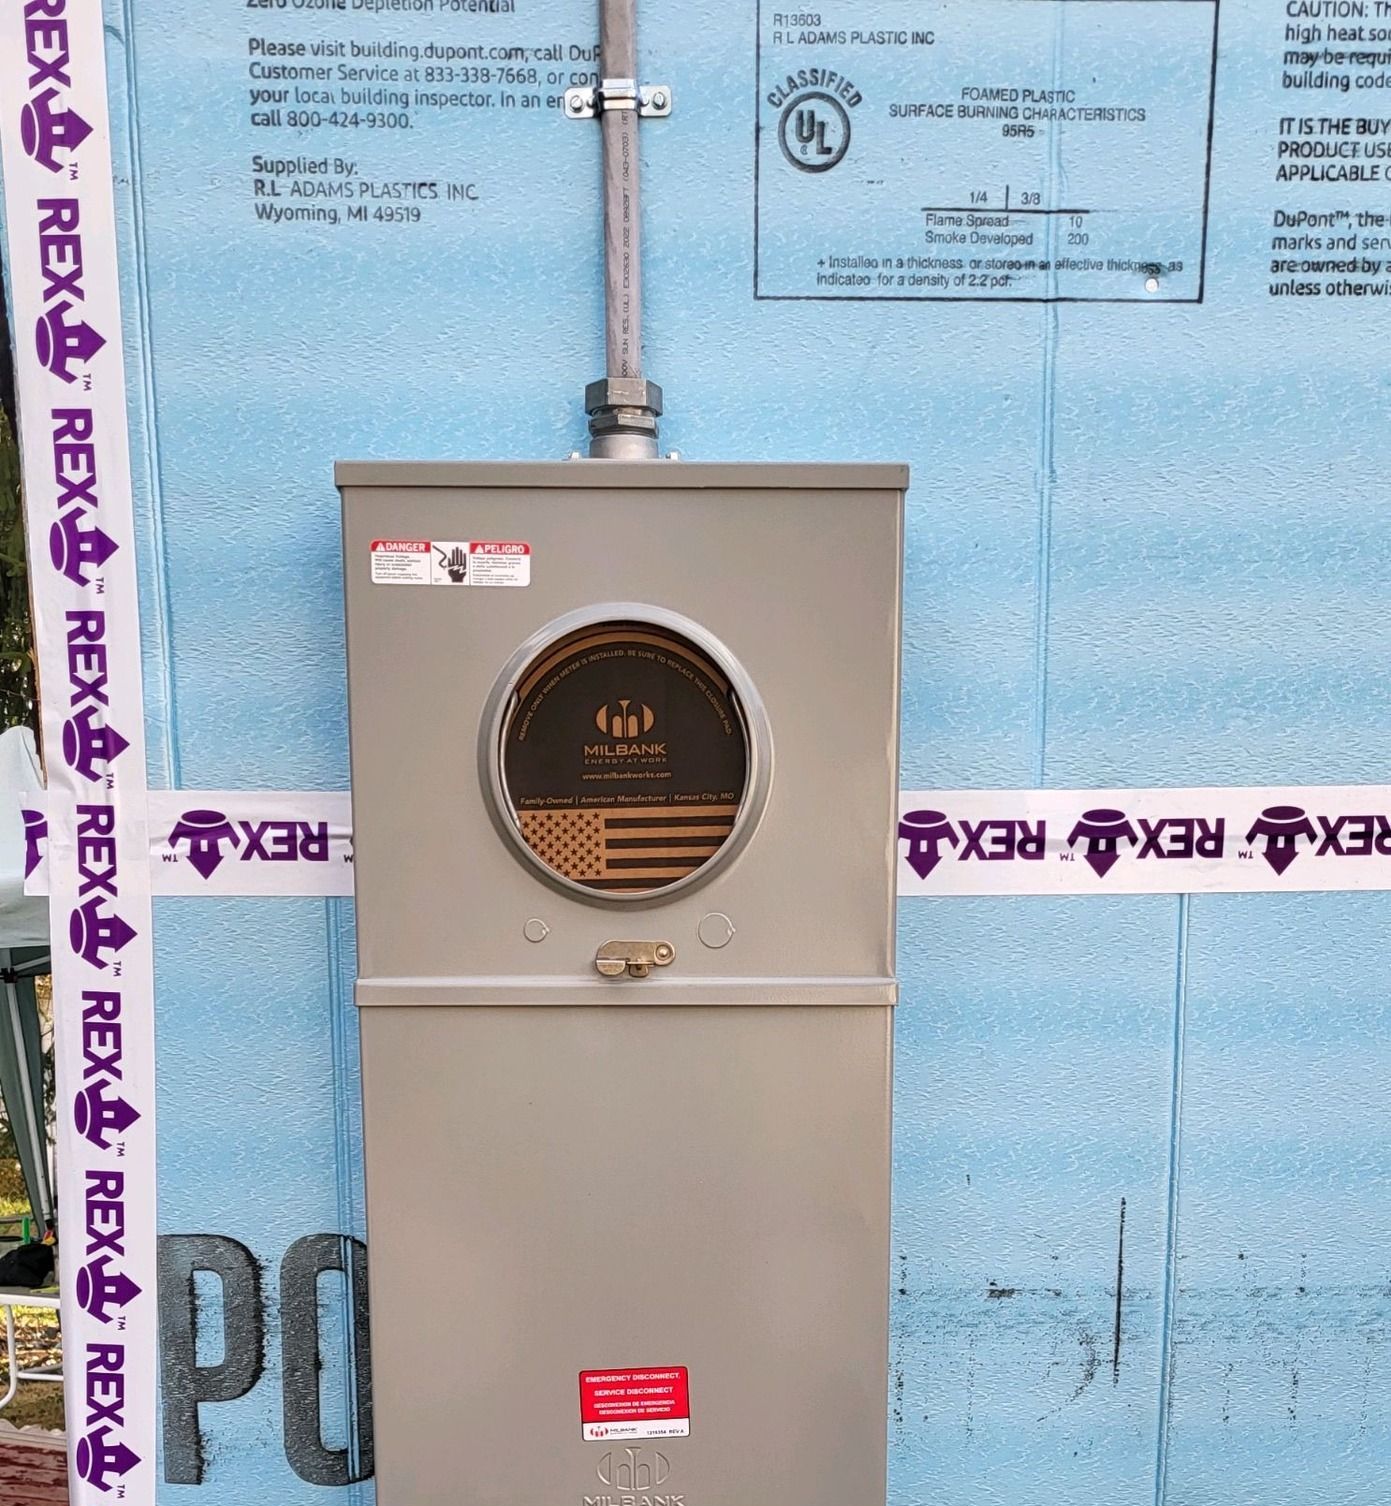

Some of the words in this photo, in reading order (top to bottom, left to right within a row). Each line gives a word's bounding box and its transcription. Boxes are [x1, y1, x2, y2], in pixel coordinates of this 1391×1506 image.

[1286, 1, 1368, 17] CAUTION:
[773, 14, 822, 27] R13603
[800, 32, 847, 45] ADAMS
[851, 32, 907, 45] PLASTIC
[911, 32, 935, 45] INC
[1285, 25, 1321, 44] high
[1327, 25, 1363, 41] heat
[248, 39, 306, 57] Please
[310, 41, 346, 57] visit
[350, 40, 529, 64] building.dupont.com,
[534, 44, 563, 61] call
[249, 62, 334, 82] Customer
[338, 64, 399, 82] Service
[404, 68, 419, 82] at
[424, 68, 541, 88] 833-338-7668,
[547, 72, 566, 86] or
[1282, 72, 1349, 92] building
[767, 68, 862, 108] CLASSIFIED
[961, 87, 1018, 102] FOAMED
[1022, 89, 1075, 104] PLASTIC
[249, 89, 289, 107] your
[294, 89, 335, 105] local
[340, 89, 409, 110] building
[414, 92, 496, 113] inspector.
[520, 96, 541, 109] an
[250, 111, 282, 127] call
[287, 112, 414, 130] 800-424-9300.
[889, 104, 955, 119] SURFACE
[958, 105, 1018, 120] BURNING
[1022, 107, 1146, 121] CHARACTERISTICS
[796, 110, 832, 154] UL
[1002, 124, 1035, 138] 95R5
[1279, 118, 1294, 135] IT
[1298, 118, 1313, 135] IS
[1318, 118, 1351, 135] THE
[1278, 141, 1360, 159] PRODUCT
[252, 156, 328, 179] Supplied
[333, 158, 358, 177] By:
[1276, 165, 1380, 182] APPLICABLE
[290, 181, 353, 198] ADAMS
[358, 182, 438, 200] PLASTICS
[447, 184, 479, 201] INC
[969, 191, 988, 205] 1/4
[1021, 192, 1041, 206] 3/8
[255, 203, 342, 225] Wyoming,
[347, 205, 368, 221] MI
[373, 205, 421, 223] 49519
[925, 214, 962, 228] Flame
[966, 214, 1010, 231] Spread
[1069, 215, 1083, 229] 10
[925, 231, 967, 246] Smoke
[970, 231, 1033, 248] Developed
[1067, 233, 1089, 247] 200
[1272, 234, 1322, 250] marks
[1326, 234, 1357, 250] and
[37, 198, 85, 302] REX
[907, 257, 963, 270] thickness
[1055, 258, 1104, 272] effective
[1301, 257, 1356, 273] owned
[1360, 257, 1381, 276] by
[908, 274, 949, 289] density
[1269, 280, 1320, 296] unless
[51, 408, 98, 508] REX
[386, 542, 426, 552] DANGER
[484, 544, 525, 554] PELIGRO
[65, 611, 109, 706] REX
[584, 743, 666, 756] MILBANK
[582, 770, 672, 781] www.milbankworks.com
[581, 795, 615, 804] American
[617, 794, 667, 804] Manufacturer
[674, 793, 699, 802] Kansas
[238, 821, 329, 862] REX
[958, 820, 1046, 861] REX
[1137, 818, 1225, 859] REX
[76, 804, 118, 897] REX
[81, 991, 122, 1080] REX
[86, 1344, 125, 1427] REX
[585, 1375, 631, 1383] EMERGENCY
[626, 1386, 673, 1395] DISCONNECT
